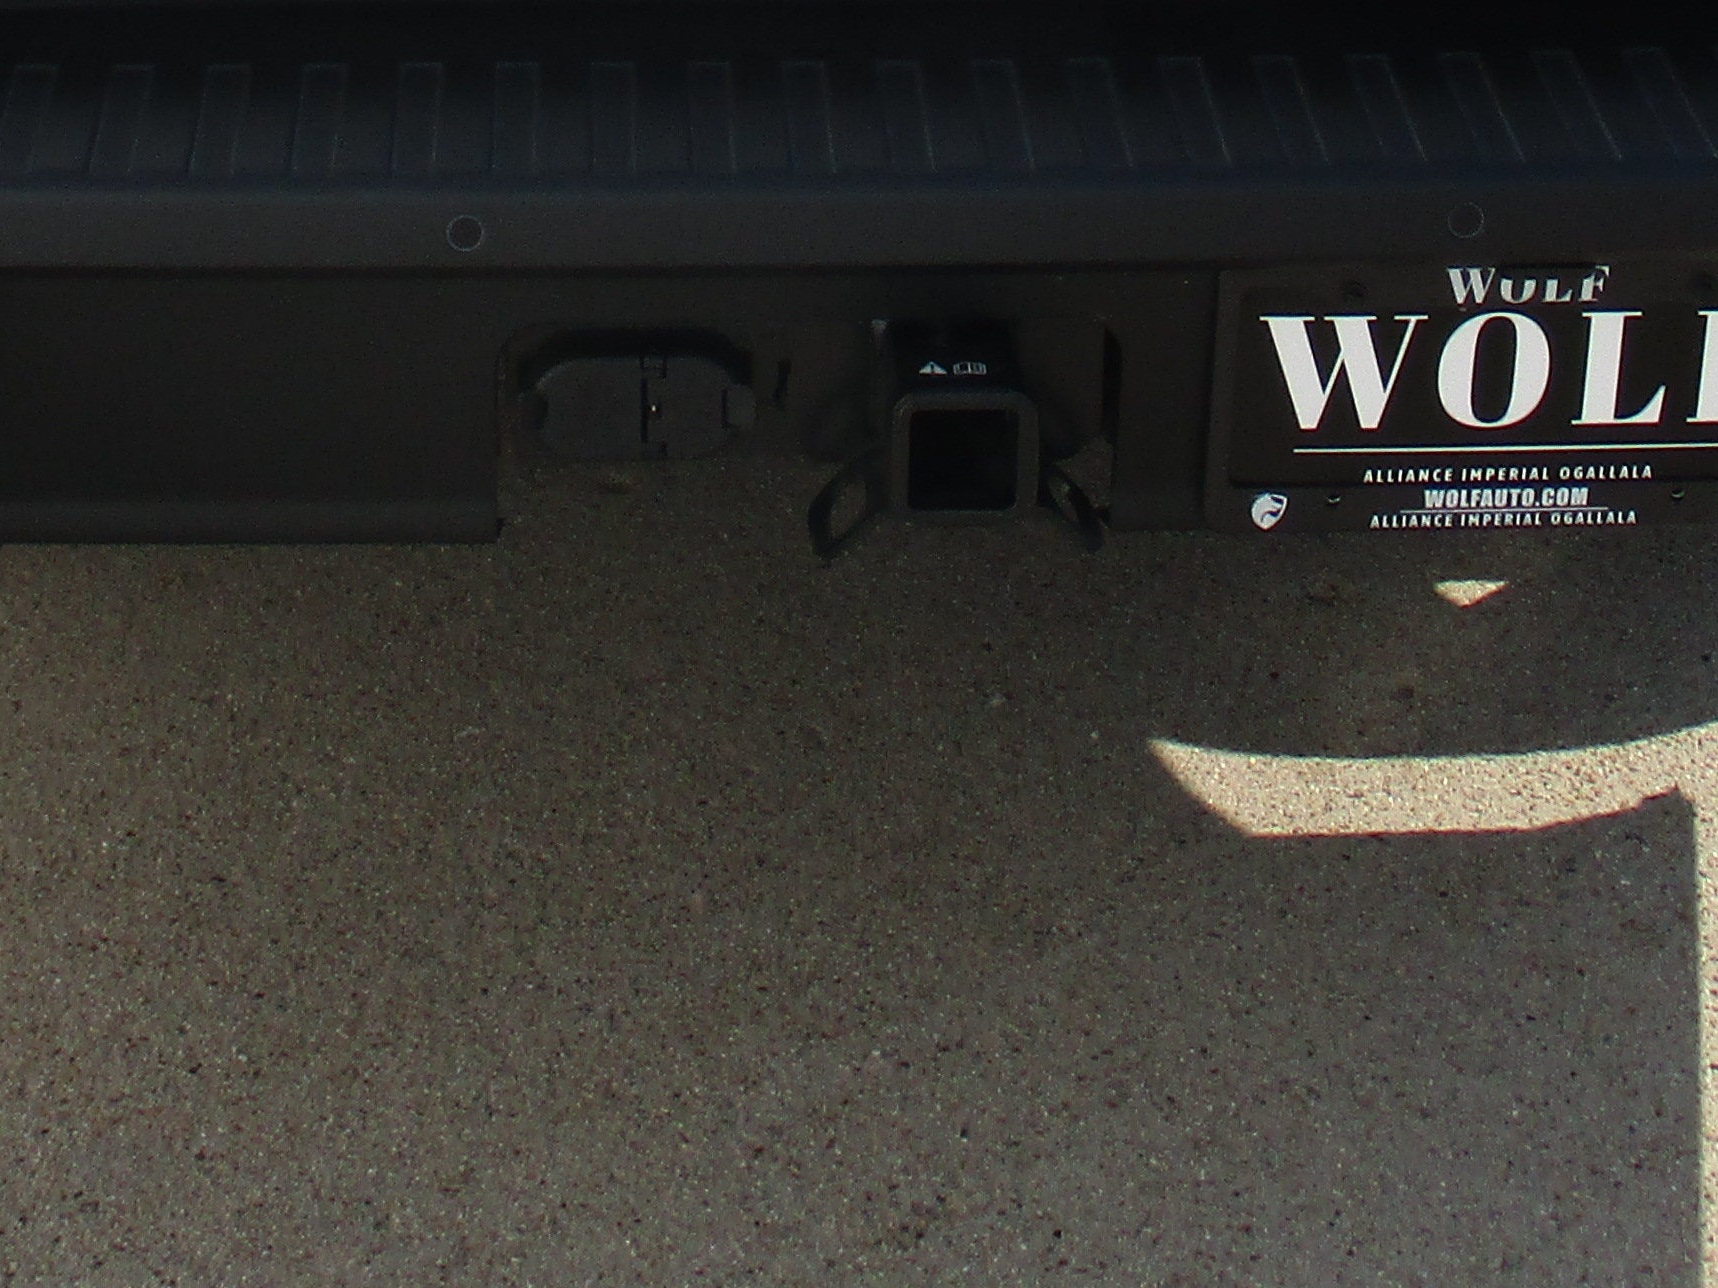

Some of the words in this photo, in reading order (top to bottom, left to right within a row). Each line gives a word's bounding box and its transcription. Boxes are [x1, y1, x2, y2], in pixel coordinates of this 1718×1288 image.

[1363, 469, 1453, 484] ALLIANCE
[1461, 467, 1549, 482] IMPERIAL
[1559, 465, 1653, 480] OGALLALA
[1424, 487, 1588, 508] WOLFAUTO.COM
[1370, 513, 1452, 529] ALLIANCE
[1460, 512, 1542, 527] IMPERIAL
[1550, 510, 1637, 525] OGALLALA
